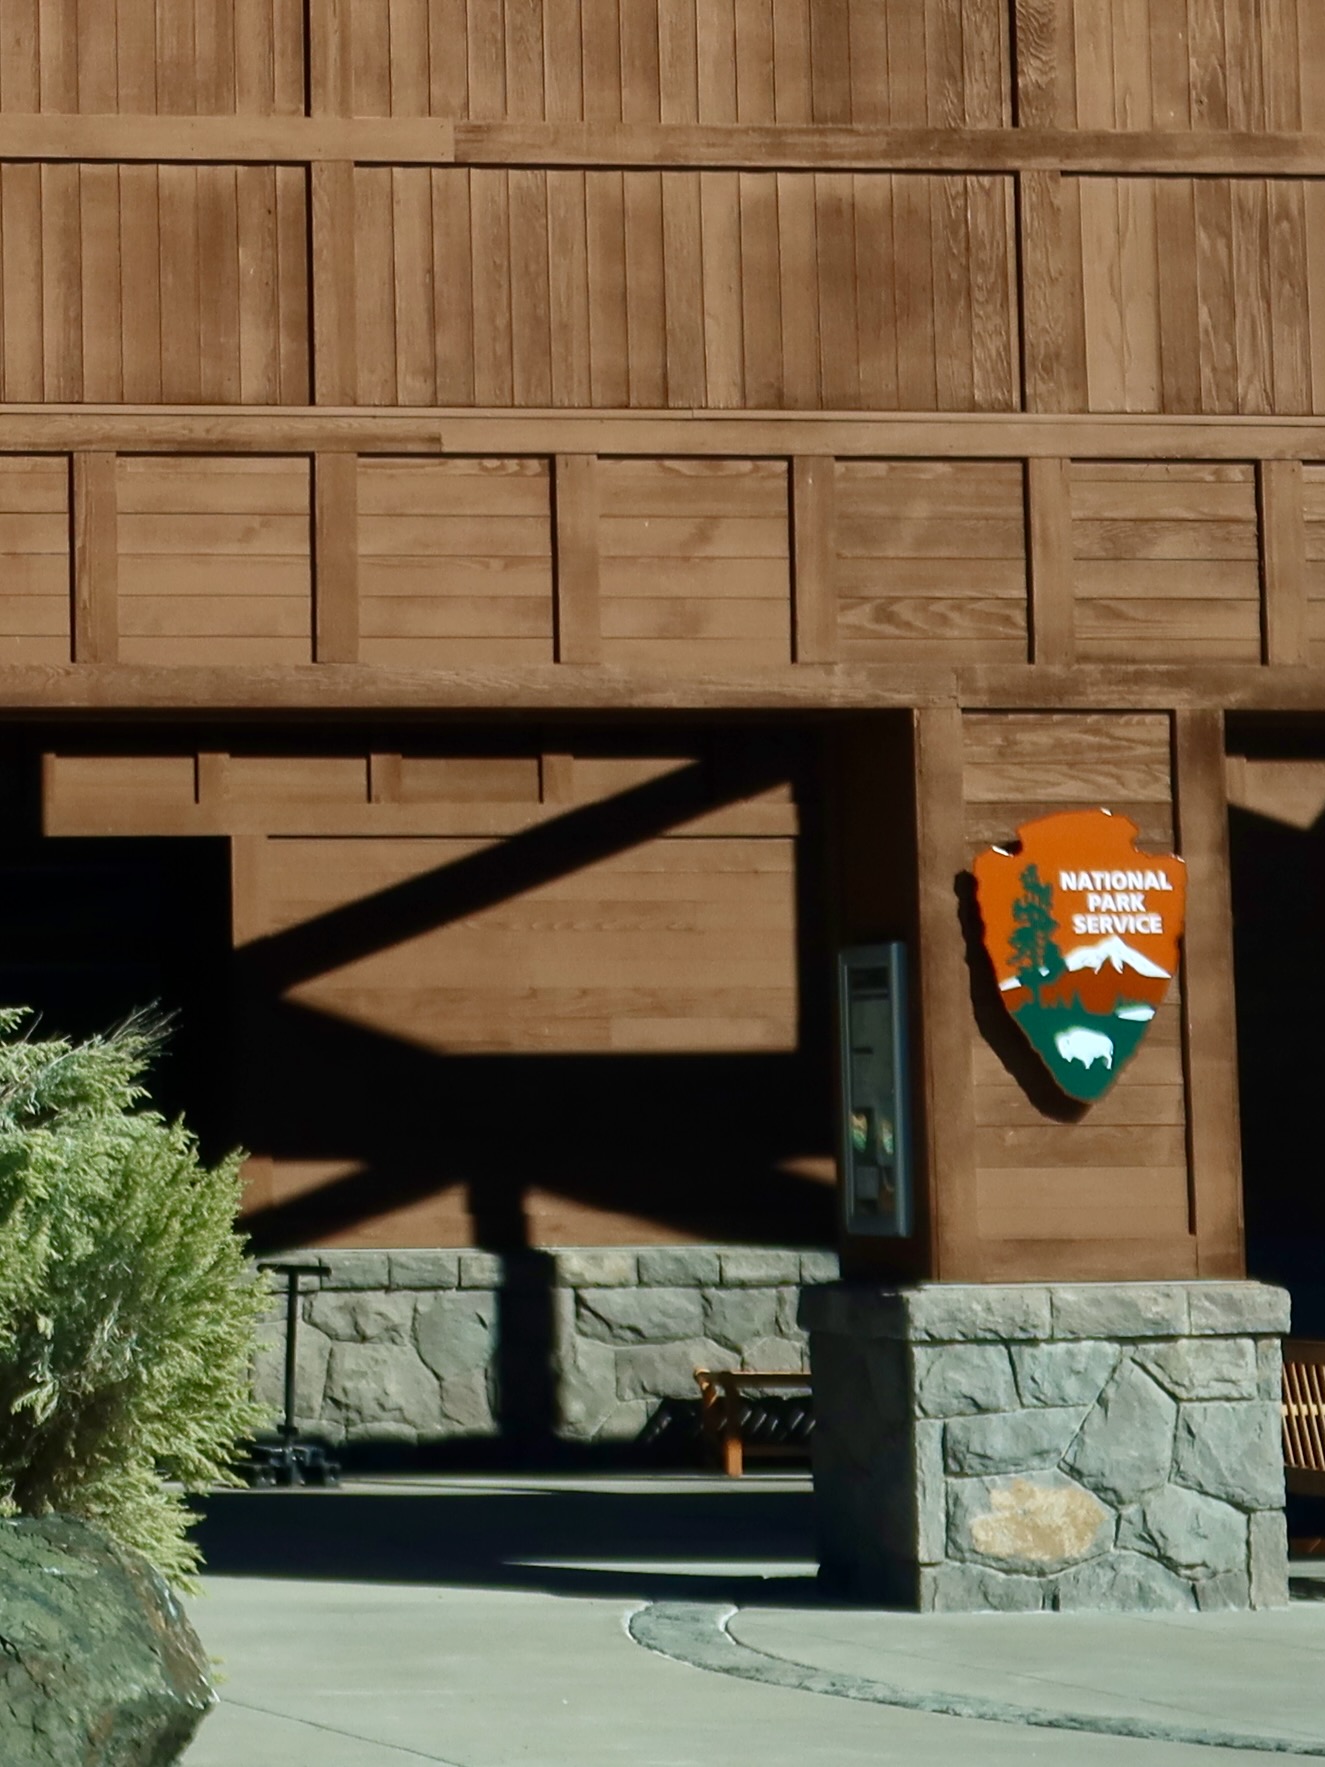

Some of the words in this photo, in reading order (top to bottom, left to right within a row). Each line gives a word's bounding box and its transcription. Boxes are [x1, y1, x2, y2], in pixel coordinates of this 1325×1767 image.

[1060, 870, 1173, 891] NATIONAL
[1087, 892, 1146, 912] PARK
[1072, 913, 1163, 934] SERVICE
